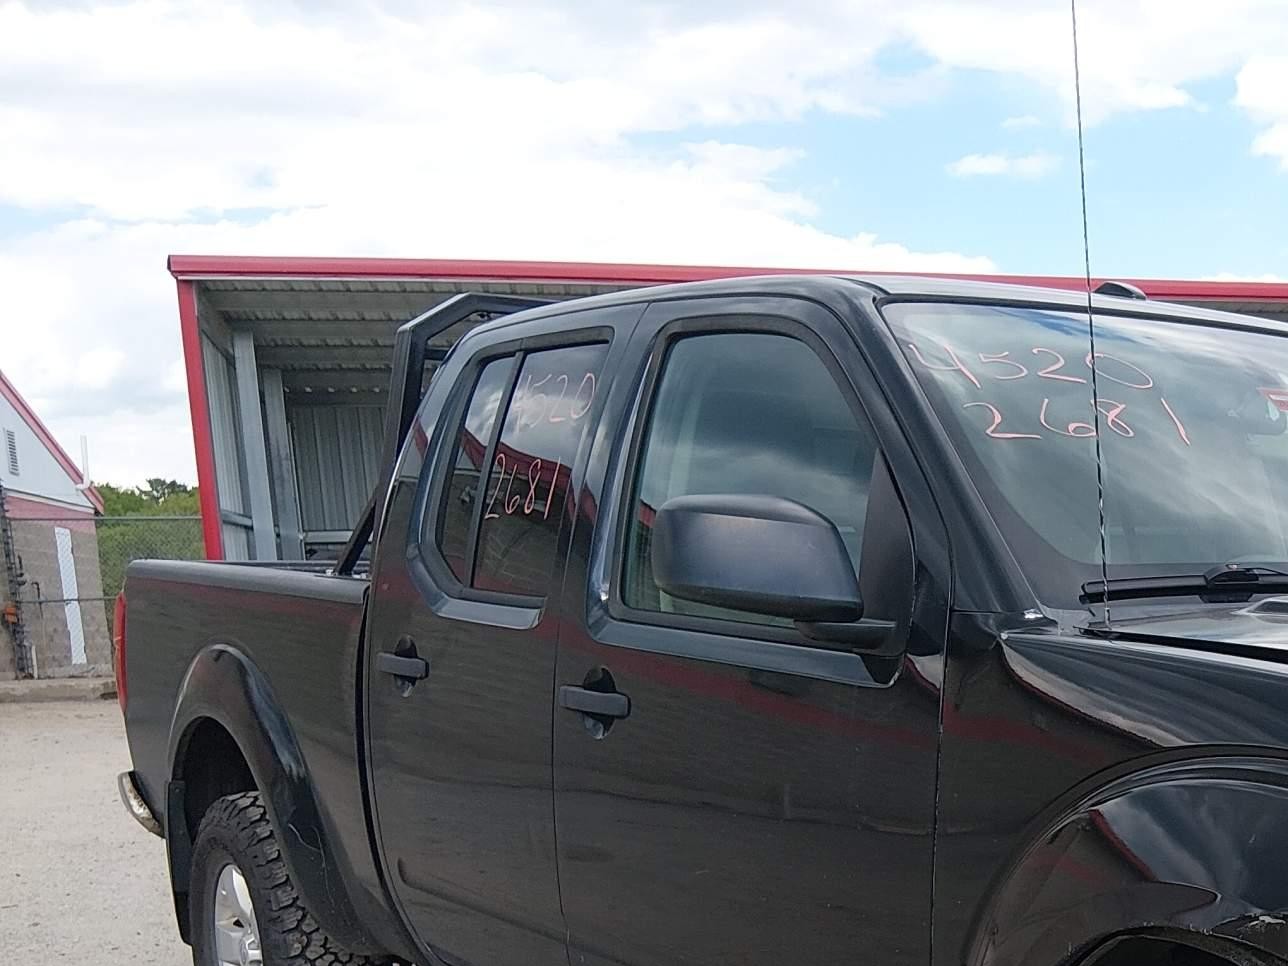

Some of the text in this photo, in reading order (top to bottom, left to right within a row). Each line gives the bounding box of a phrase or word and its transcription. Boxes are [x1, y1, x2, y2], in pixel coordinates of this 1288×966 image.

[908, 343, 1154, 390] 4520
[512, 372, 597, 433] 4520
[963, 397, 1192, 446] 2681
[484, 453, 562, 521] 2681
